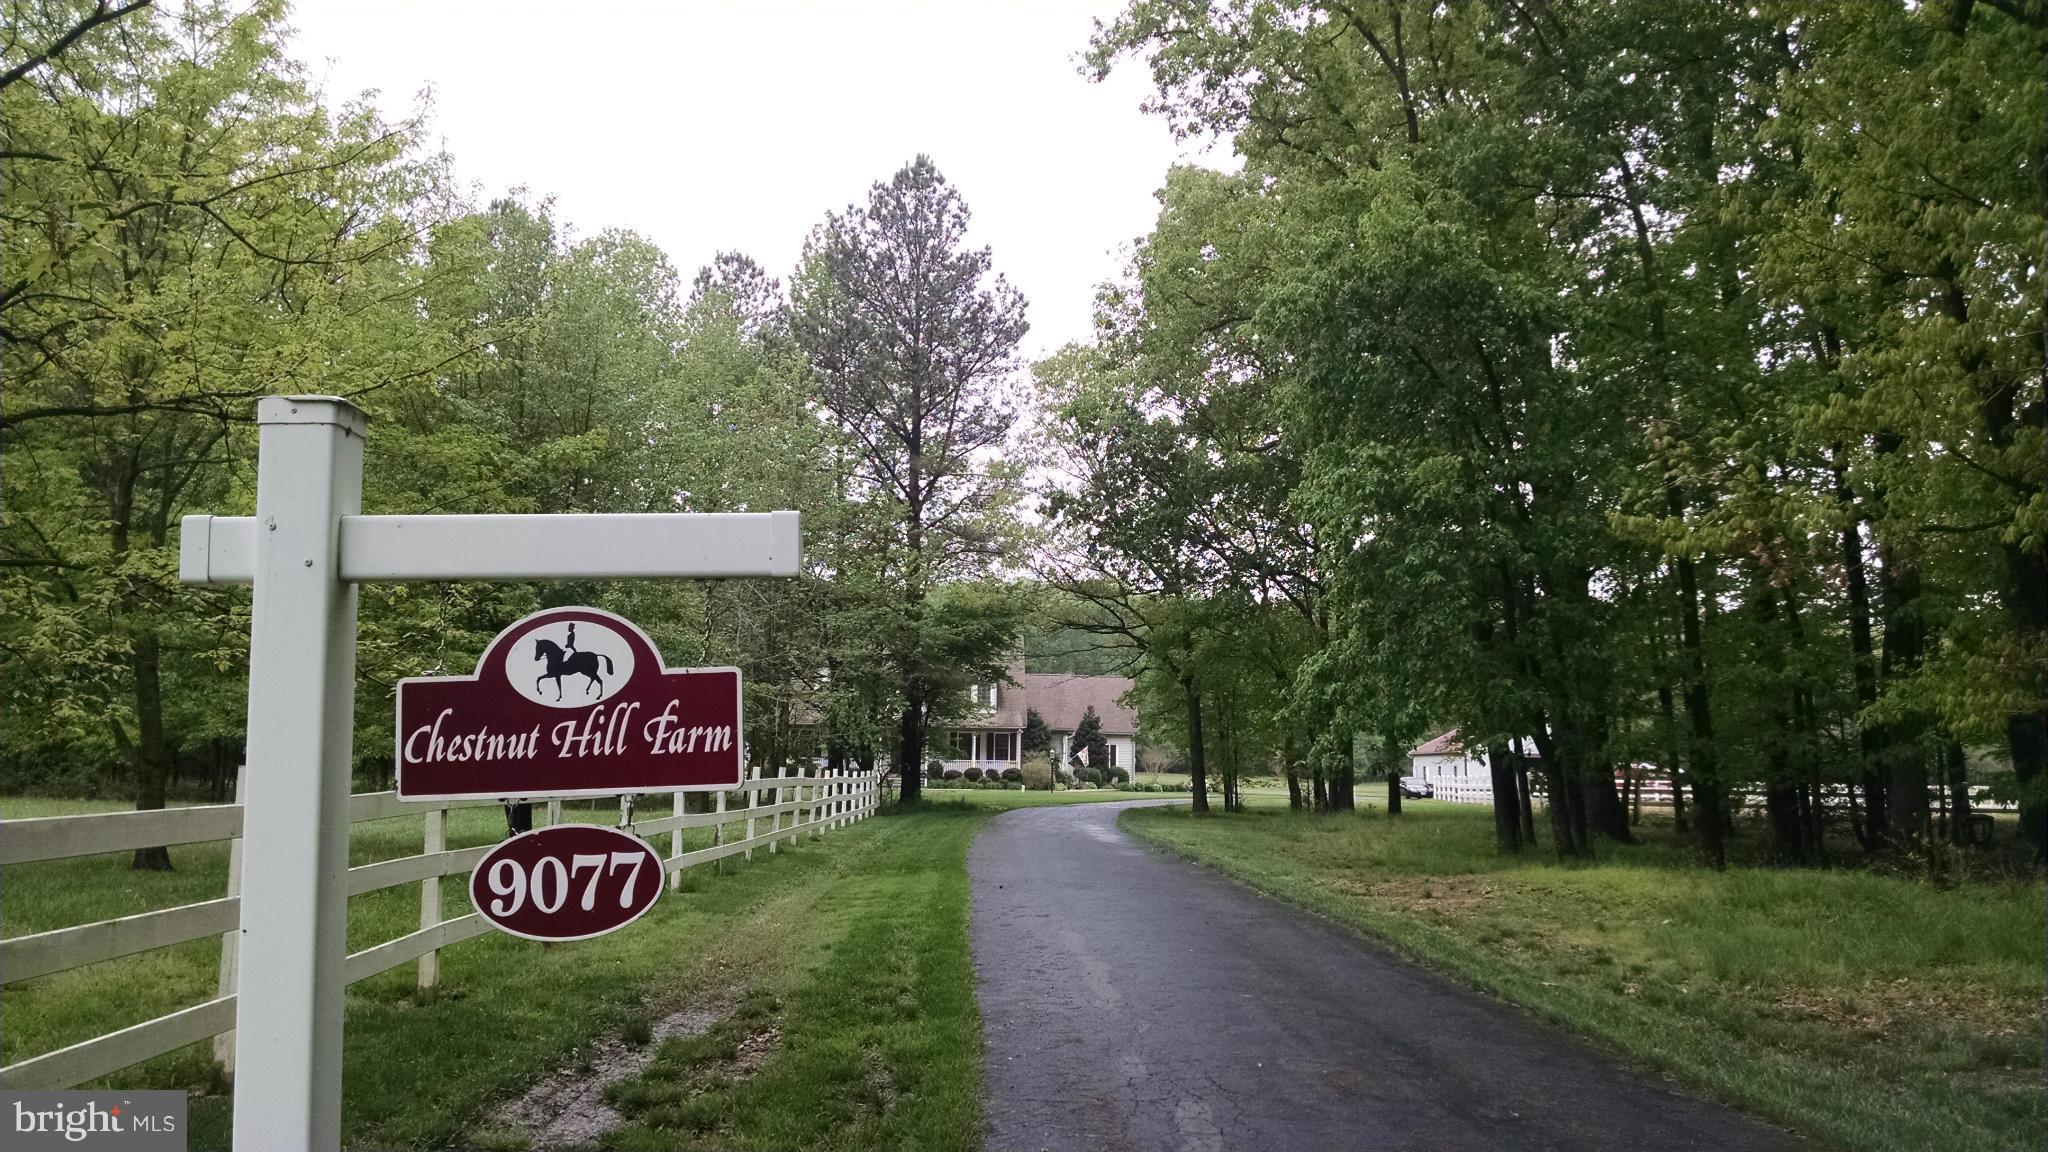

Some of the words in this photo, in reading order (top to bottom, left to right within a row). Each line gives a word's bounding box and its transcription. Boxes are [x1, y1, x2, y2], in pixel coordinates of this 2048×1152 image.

[403, 707, 540, 764] Chestnut
[551, 701, 640, 759] Hill
[643, 699, 733, 756] Farm
[487, 851, 646, 917] 9077
